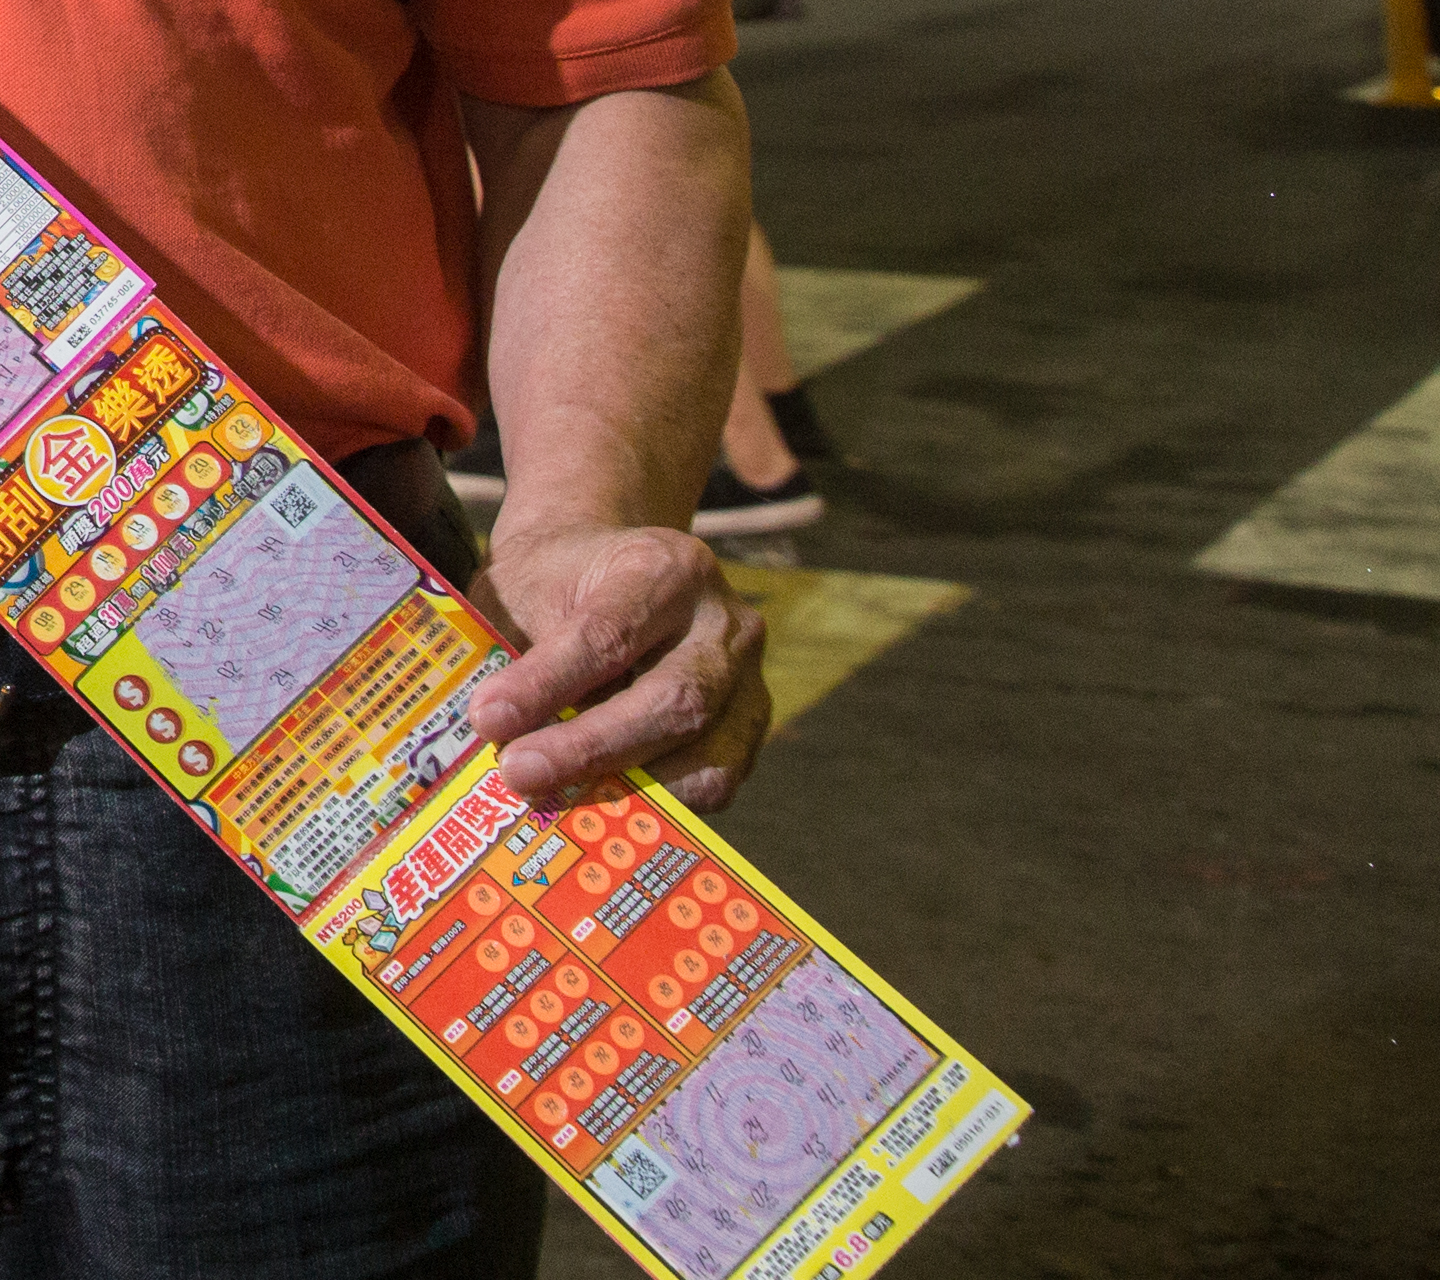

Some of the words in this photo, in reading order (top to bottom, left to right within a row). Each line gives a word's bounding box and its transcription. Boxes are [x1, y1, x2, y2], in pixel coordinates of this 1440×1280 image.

[88, 278, 135, 326] 037765-002
[54, 439, 172, 556] 頭獎200萬元
[127, 519, 143, 535] 13
[334, 548, 354, 568] 21
[36, 610, 53, 628] 08
[198, 618, 221, 641] 22
[314, 613, 337, 637] 46
[316, 896, 364, 944] NT$200
[795, 997, 818, 1020] 26
[837, 999, 861, 1023] 34
[817, 1085, 837, 1105] 41
[741, 1116, 766, 1141] 24
[663, 1195, 687, 1218] 06
